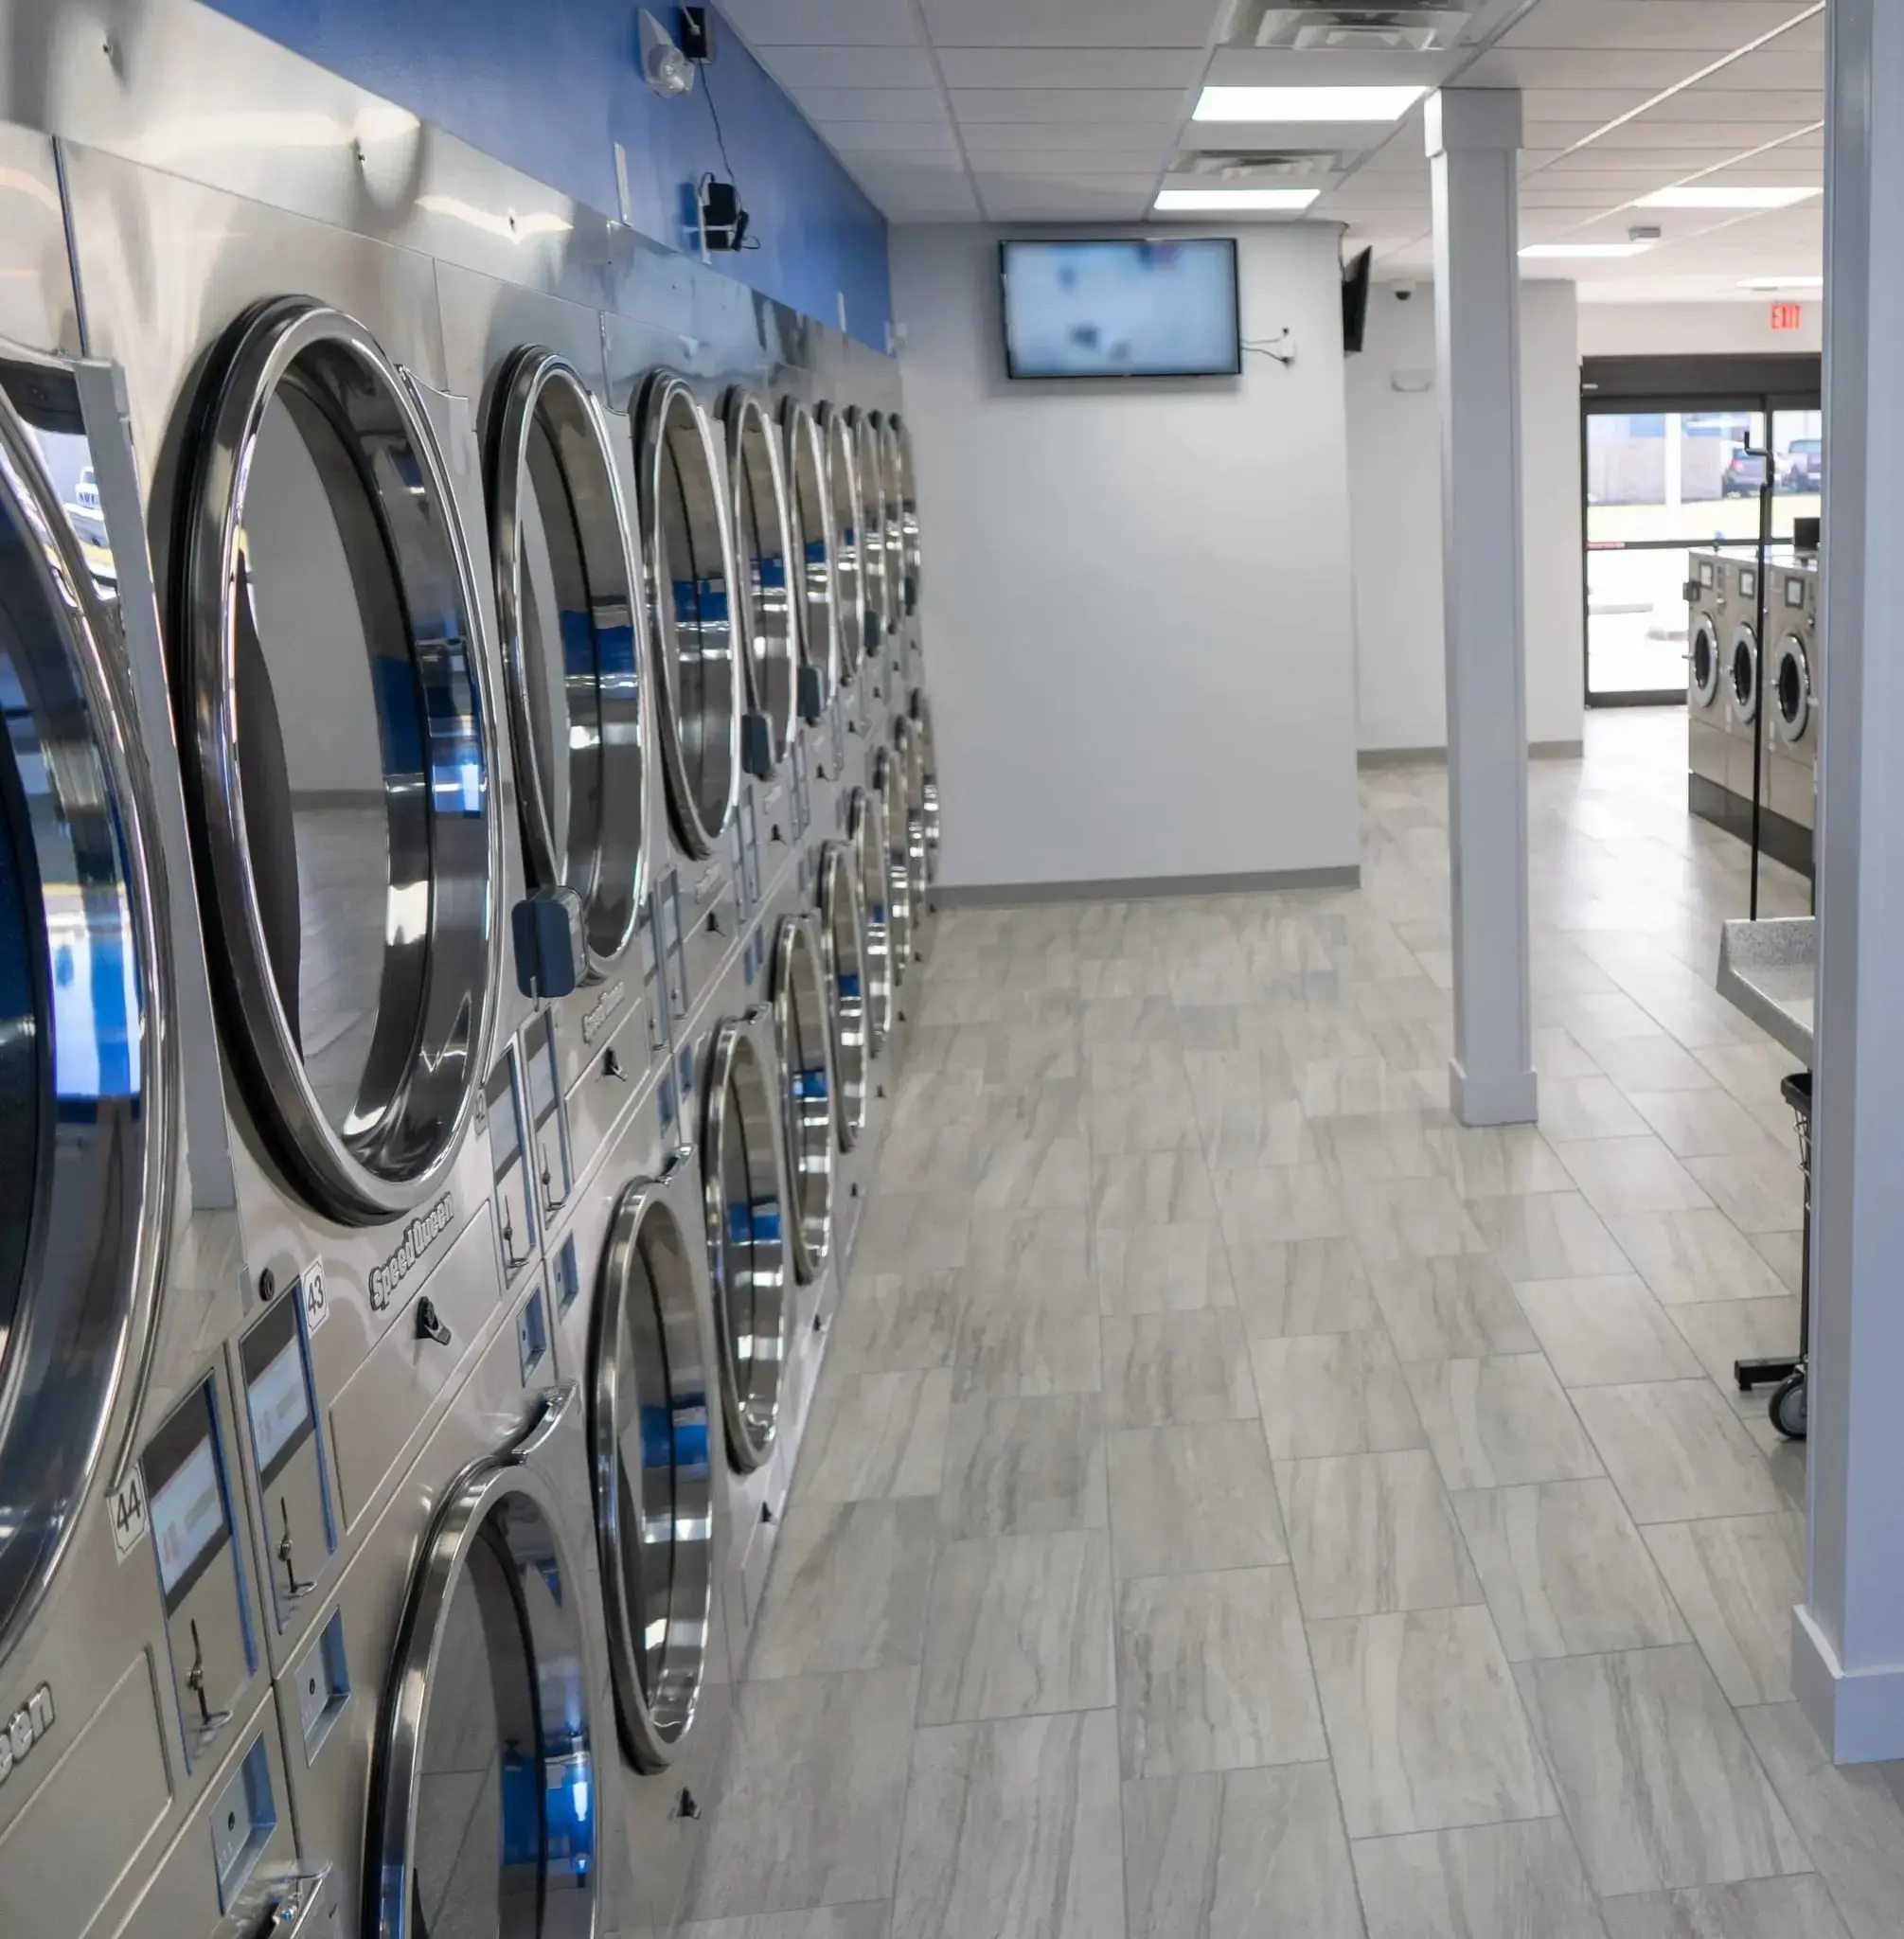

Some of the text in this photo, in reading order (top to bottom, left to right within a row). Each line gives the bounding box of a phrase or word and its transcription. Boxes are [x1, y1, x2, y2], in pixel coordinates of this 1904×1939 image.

[1770, 303, 1802, 330] EXIT
[308, 1274, 324, 1315] 43
[116, 1480, 141, 1533] 44
